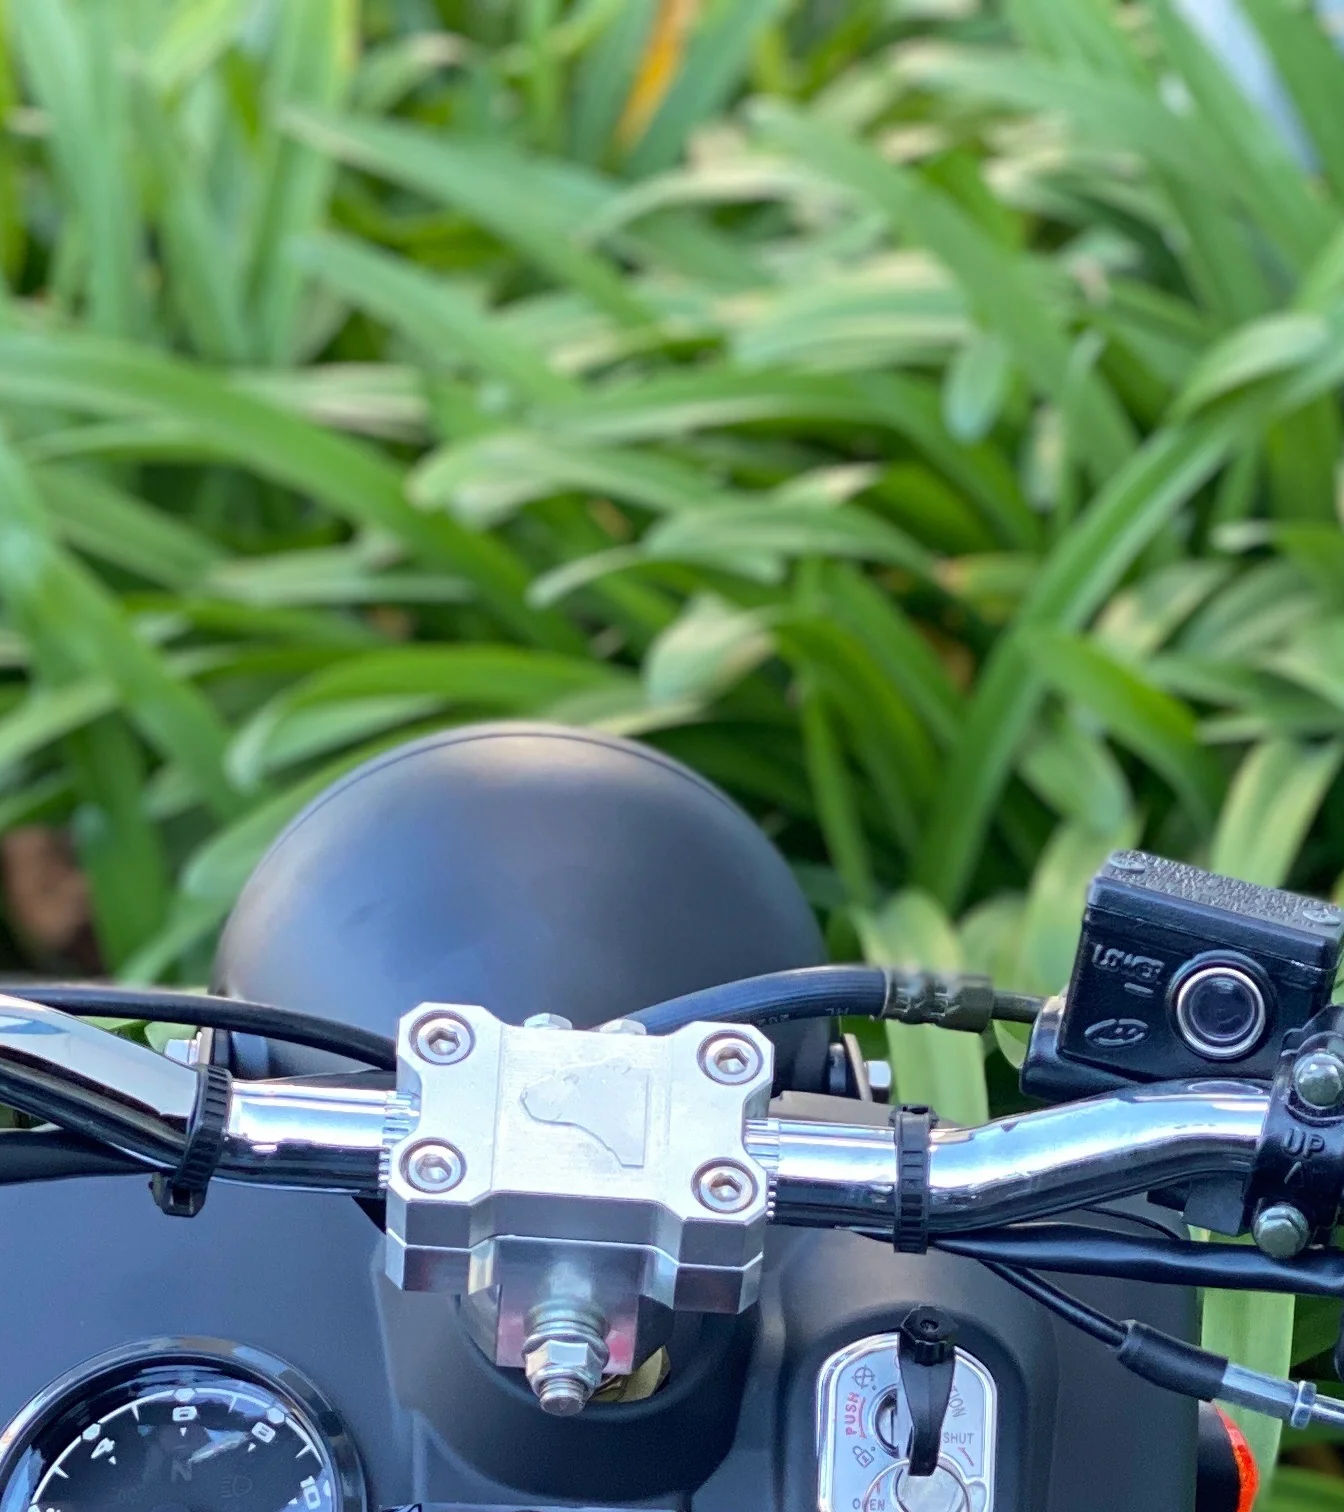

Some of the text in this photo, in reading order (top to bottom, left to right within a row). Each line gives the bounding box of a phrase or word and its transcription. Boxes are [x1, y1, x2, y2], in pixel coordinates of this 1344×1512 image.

[1284, 1127, 1325, 1159] UP
[844, 1391, 860, 1436] PUSH
[91, 1438, 117, 1460] 4
[943, 1432, 974, 1445] SHUT
[852, 1498, 886, 1511] OEN
